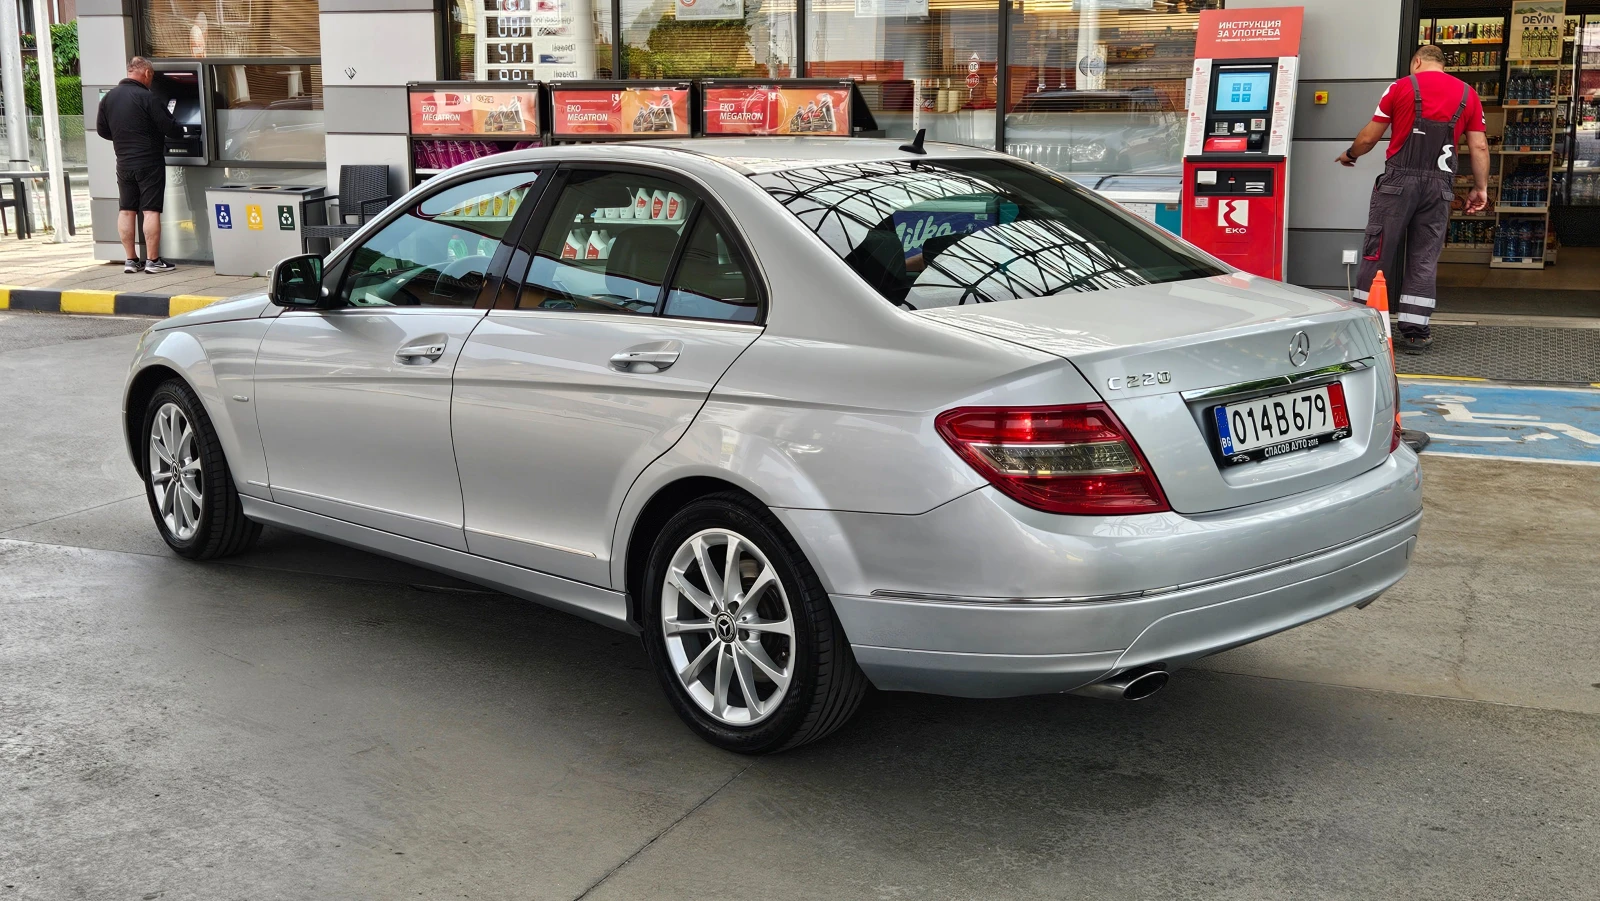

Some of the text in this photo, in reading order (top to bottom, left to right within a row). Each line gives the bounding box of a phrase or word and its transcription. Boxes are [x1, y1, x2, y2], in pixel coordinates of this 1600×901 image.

[1522, 15, 1555, 24] DEVIN
[1219, 20, 1281, 29] ИНСТРУКЦИЯ
[1232, 28, 1280, 37] УПОТРЕБА
[720, 103, 734, 111] EKO
[422, 113, 460, 121] MEGATRON
[720, 112, 763, 120] MEGATRON
[1108, 370, 1171, 390] C 220
[1232, 394, 1327, 445] 014B679
[1221, 436, 1232, 448] BG
[1264, 443, 1290, 457] СПАСОВ
[1291, 439, 1307, 451] АУТО
